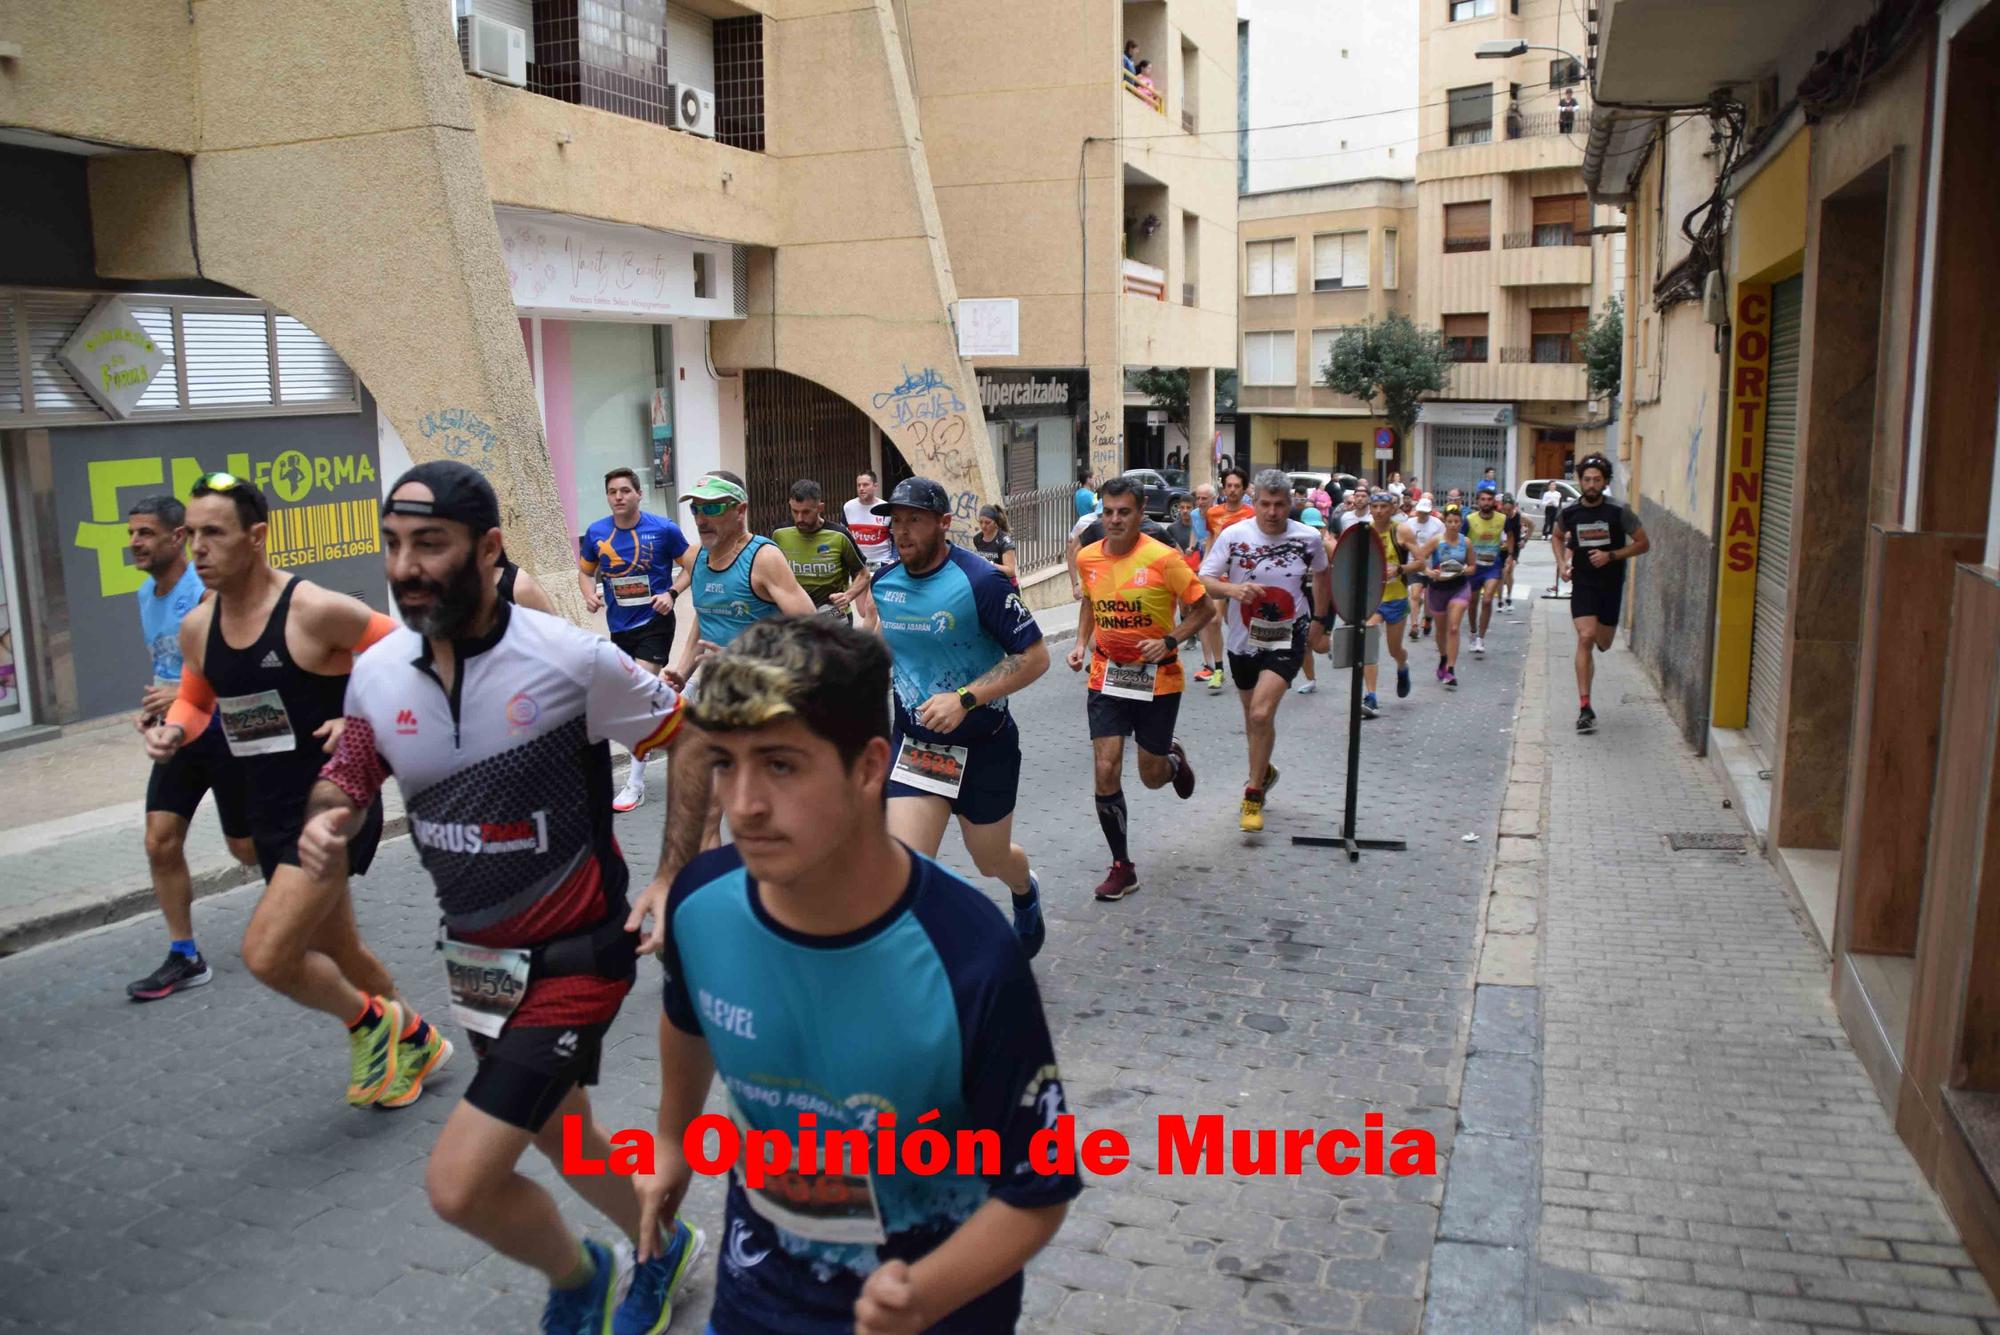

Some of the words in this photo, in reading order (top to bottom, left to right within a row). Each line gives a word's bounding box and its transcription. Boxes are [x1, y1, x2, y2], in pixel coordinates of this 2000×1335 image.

[1727, 294, 1767, 572] CORTINAS
[270, 549, 317, 569] DESDE
[324, 540, 375, 561] 061096
